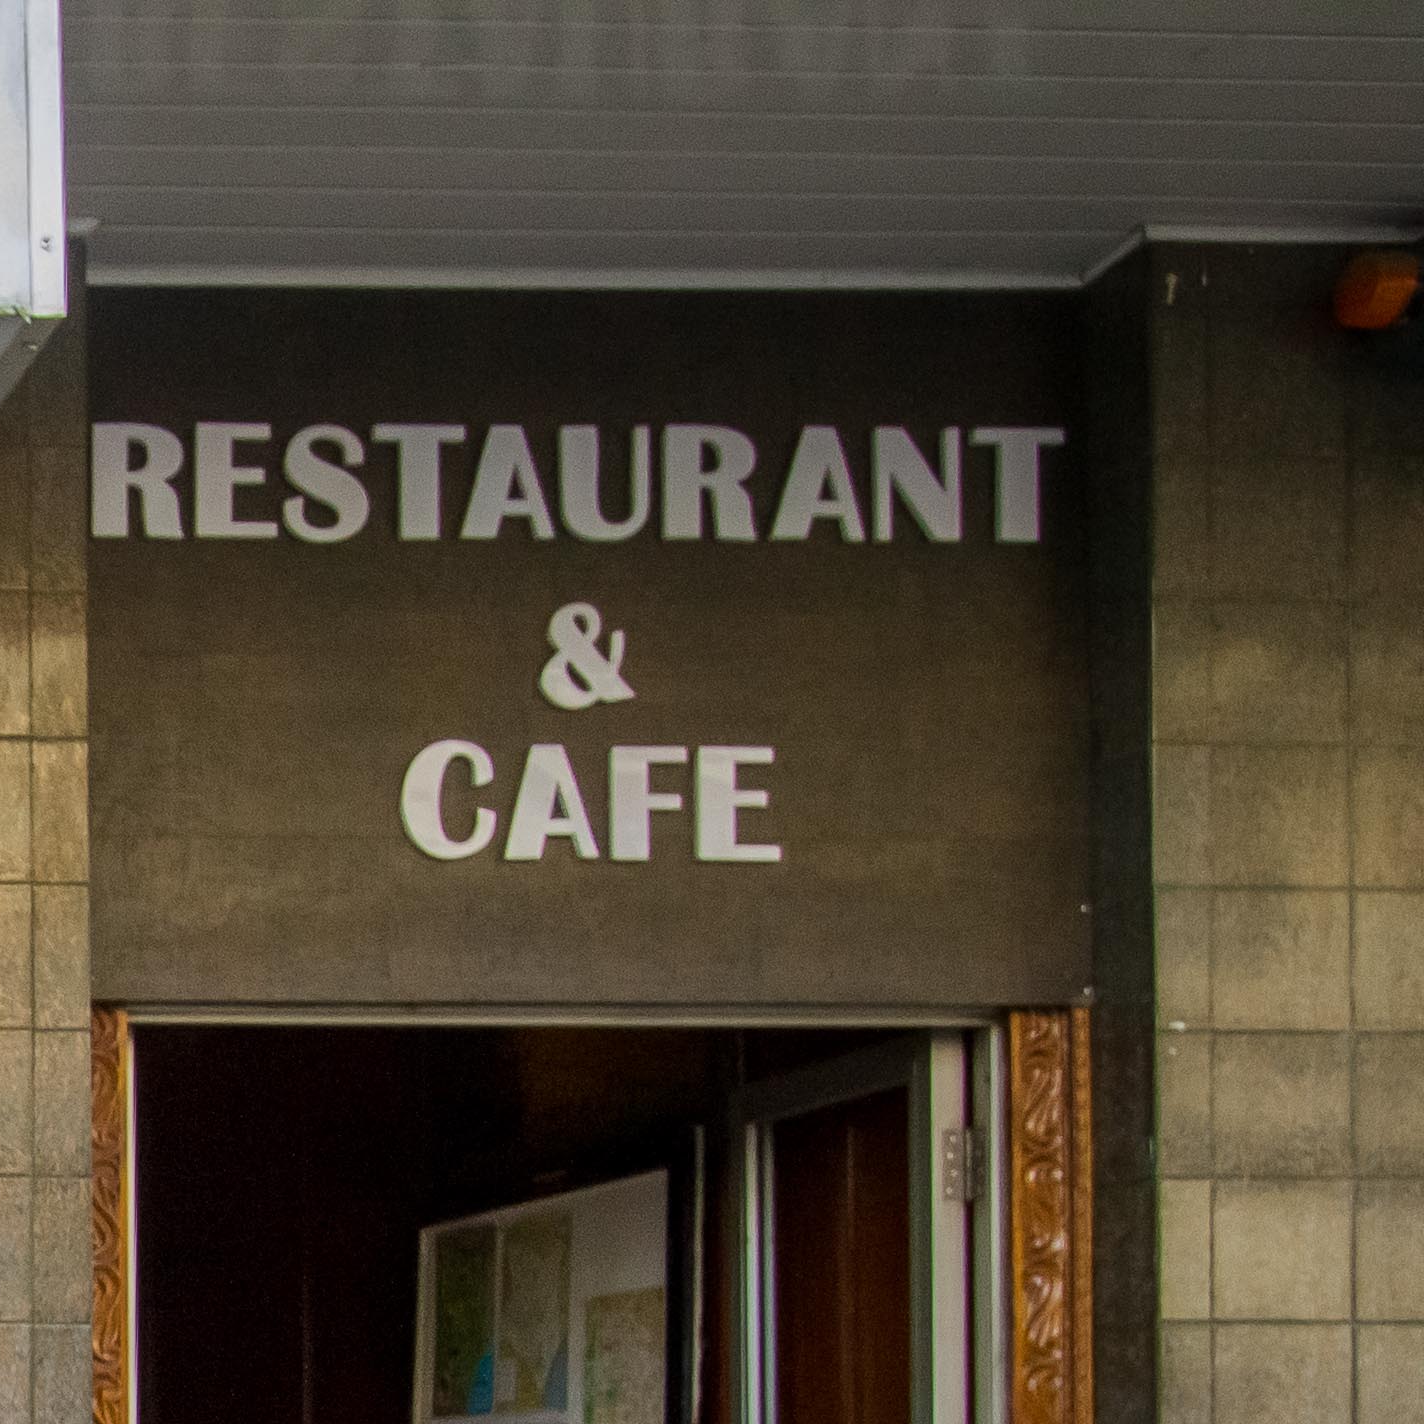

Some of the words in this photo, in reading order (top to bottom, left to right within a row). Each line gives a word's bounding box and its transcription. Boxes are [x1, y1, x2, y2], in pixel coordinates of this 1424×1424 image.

[91, 421, 1065, 544] RESTAURANT
[539, 602, 635, 711] &
[399, 738, 783, 863] CAFE
